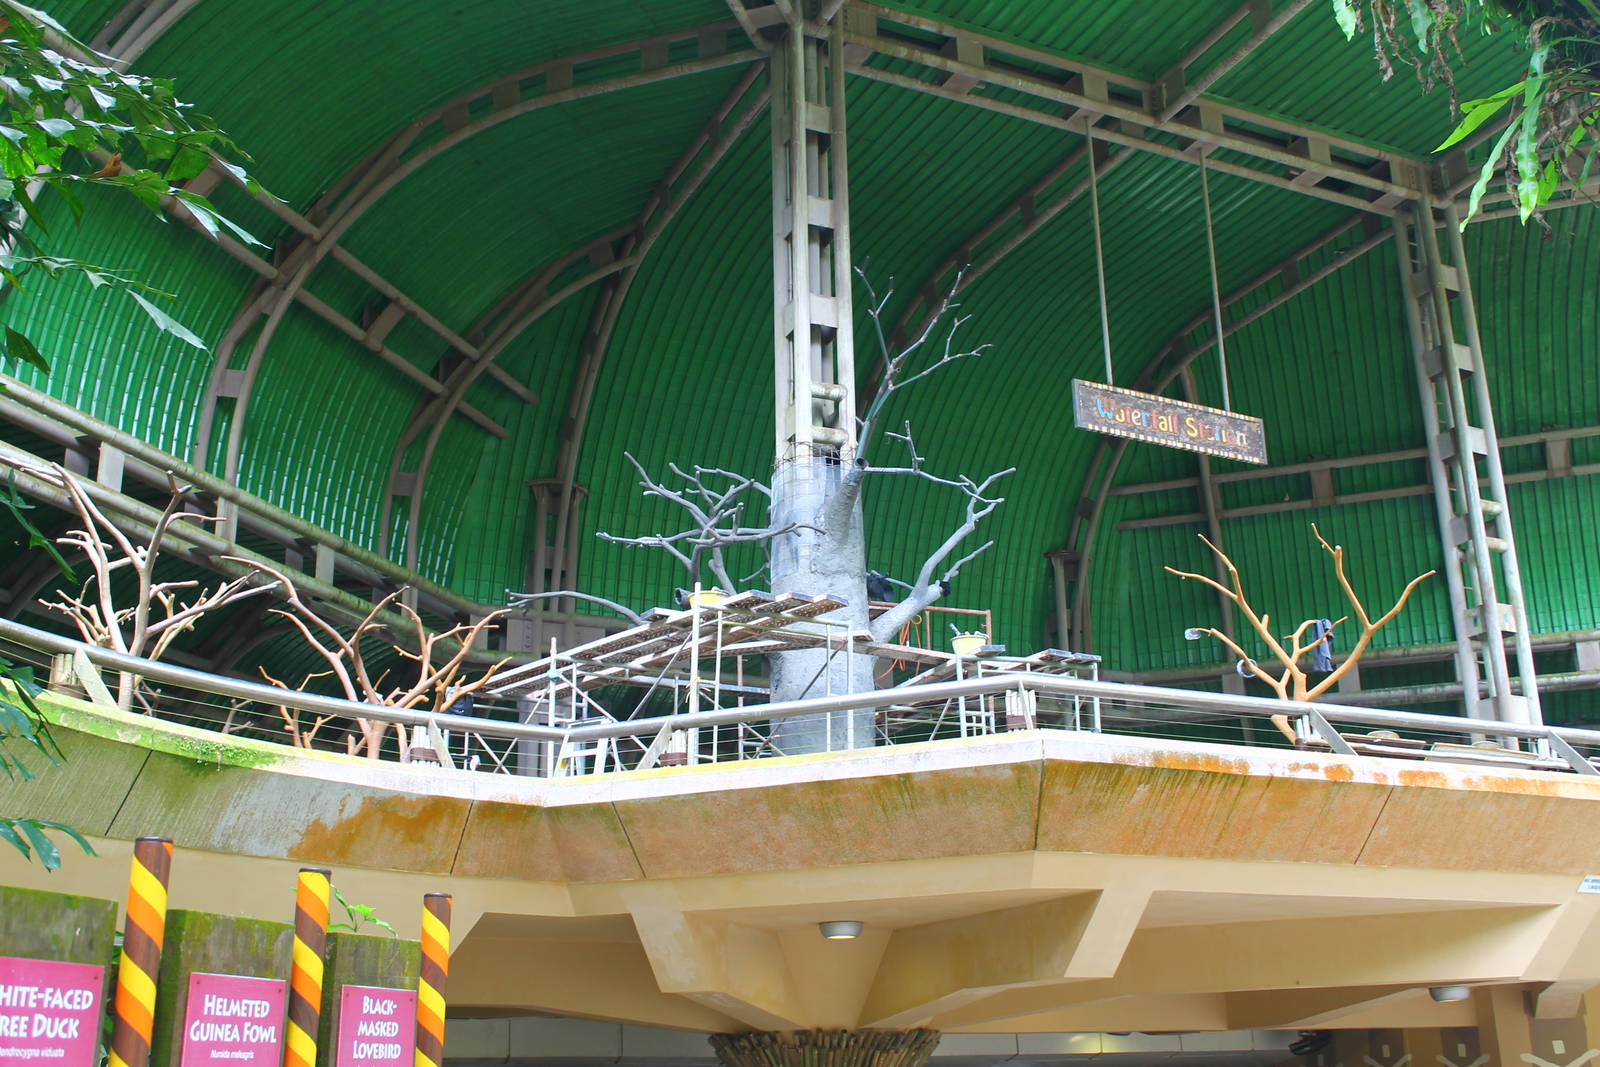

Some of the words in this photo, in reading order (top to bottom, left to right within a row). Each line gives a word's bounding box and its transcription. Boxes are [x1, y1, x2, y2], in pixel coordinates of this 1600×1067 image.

[203, 994, 271, 1018] HELMETED
[362, 995, 397, 1016] BLACK-
[32, 1013, 80, 1039] DUCK
[189, 1020, 241, 1042] GUINEA
[242, 1021, 277, 1044] FOWL
[357, 1020, 399, 1037] MASKED
[352, 1039, 402, 1060] LOVEBIRD
